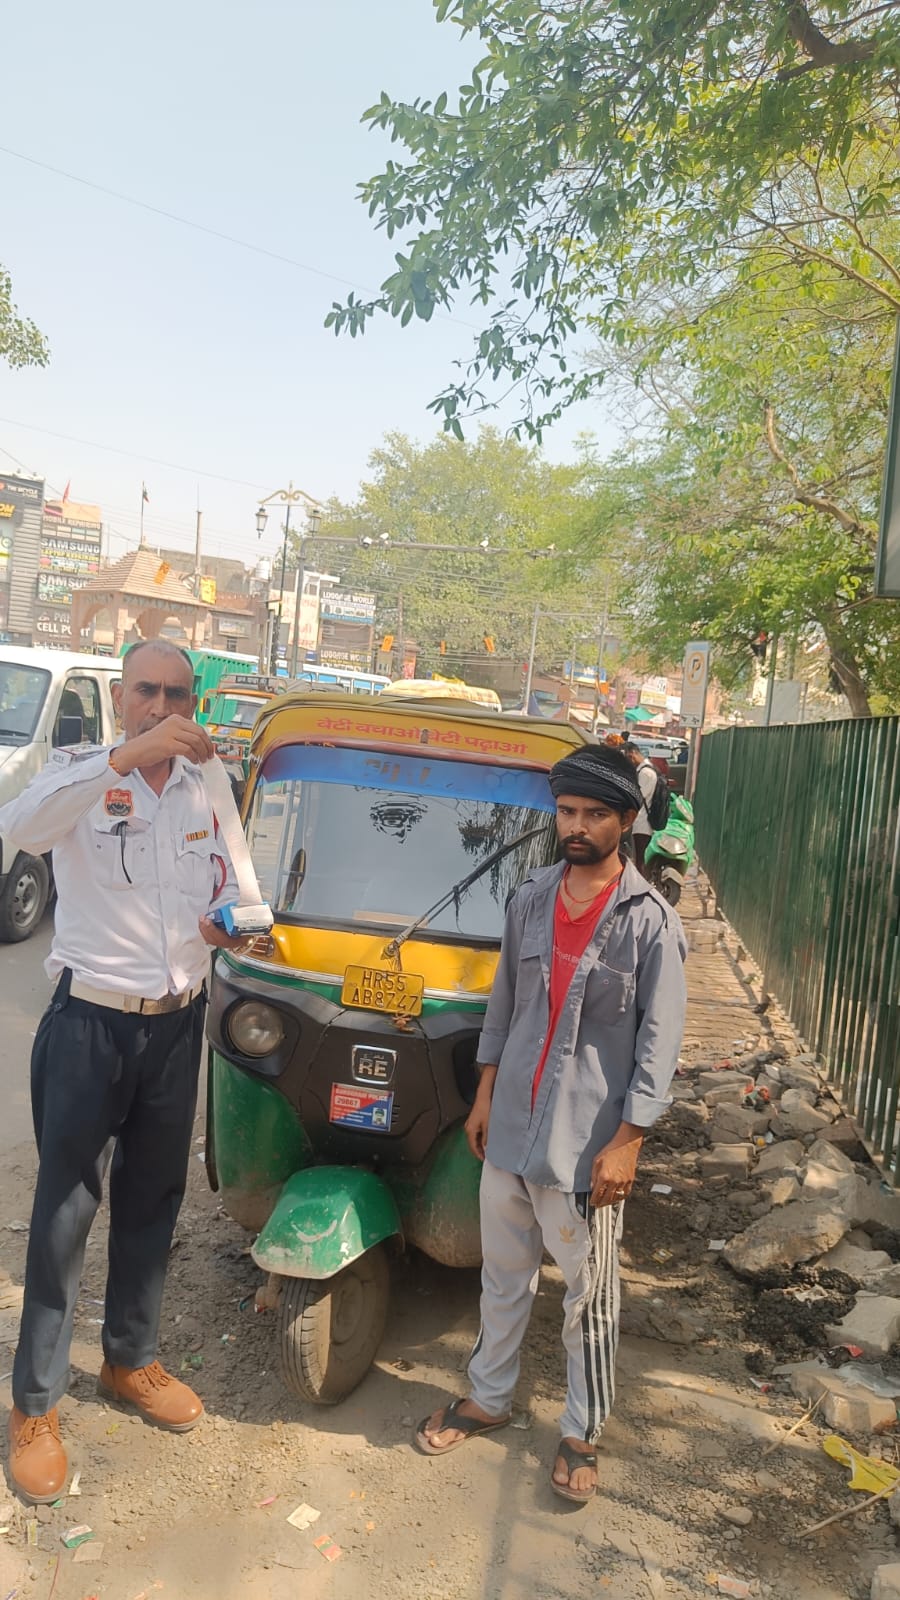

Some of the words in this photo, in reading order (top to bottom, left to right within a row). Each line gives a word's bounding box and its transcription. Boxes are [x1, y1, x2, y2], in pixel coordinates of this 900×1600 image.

[40, 537, 100, 554] SAMSUNG
[39, 573, 89, 589] SAMSUN
[352, 595, 375, 605] WORLD
[36, 622, 59, 634] CELL
[61, 624, 91, 637] POT
[317, 717, 352, 731] बेटी
[354, 722, 421, 739] बचाओ
[361, 970, 407, 992] HR55
[351, 987, 419, 1012] AB8747
[358, 1058, 388, 1077] RE
